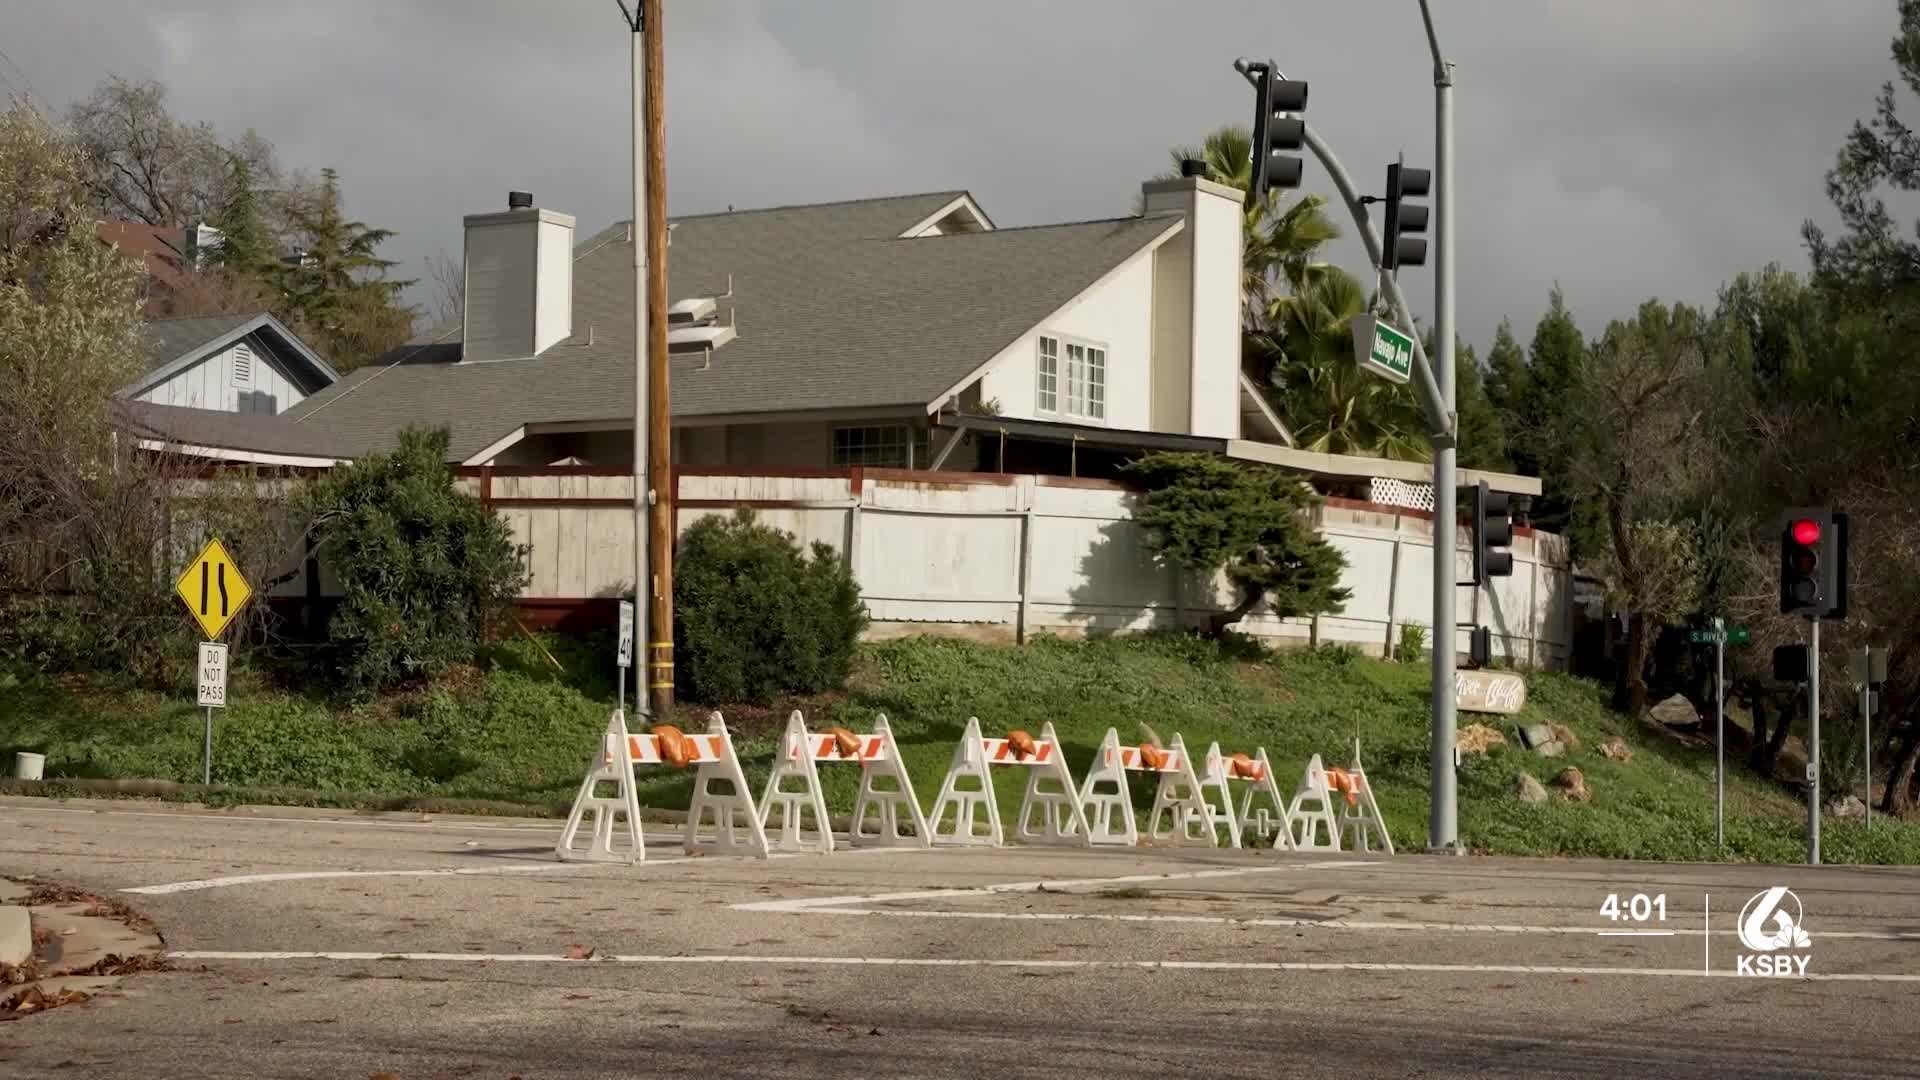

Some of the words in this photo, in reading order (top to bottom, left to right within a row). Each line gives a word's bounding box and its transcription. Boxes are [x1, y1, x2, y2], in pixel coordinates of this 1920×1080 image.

[1373, 331, 1396, 365] Navajo
[1395, 343, 1409, 368] Ave
[1702, 631, 1728, 641] RIVER
[620, 637, 631, 660] 40
[207, 650, 219, 664] DO
[204, 667, 221, 681] NOT
[200, 684, 223, 700] PASS
